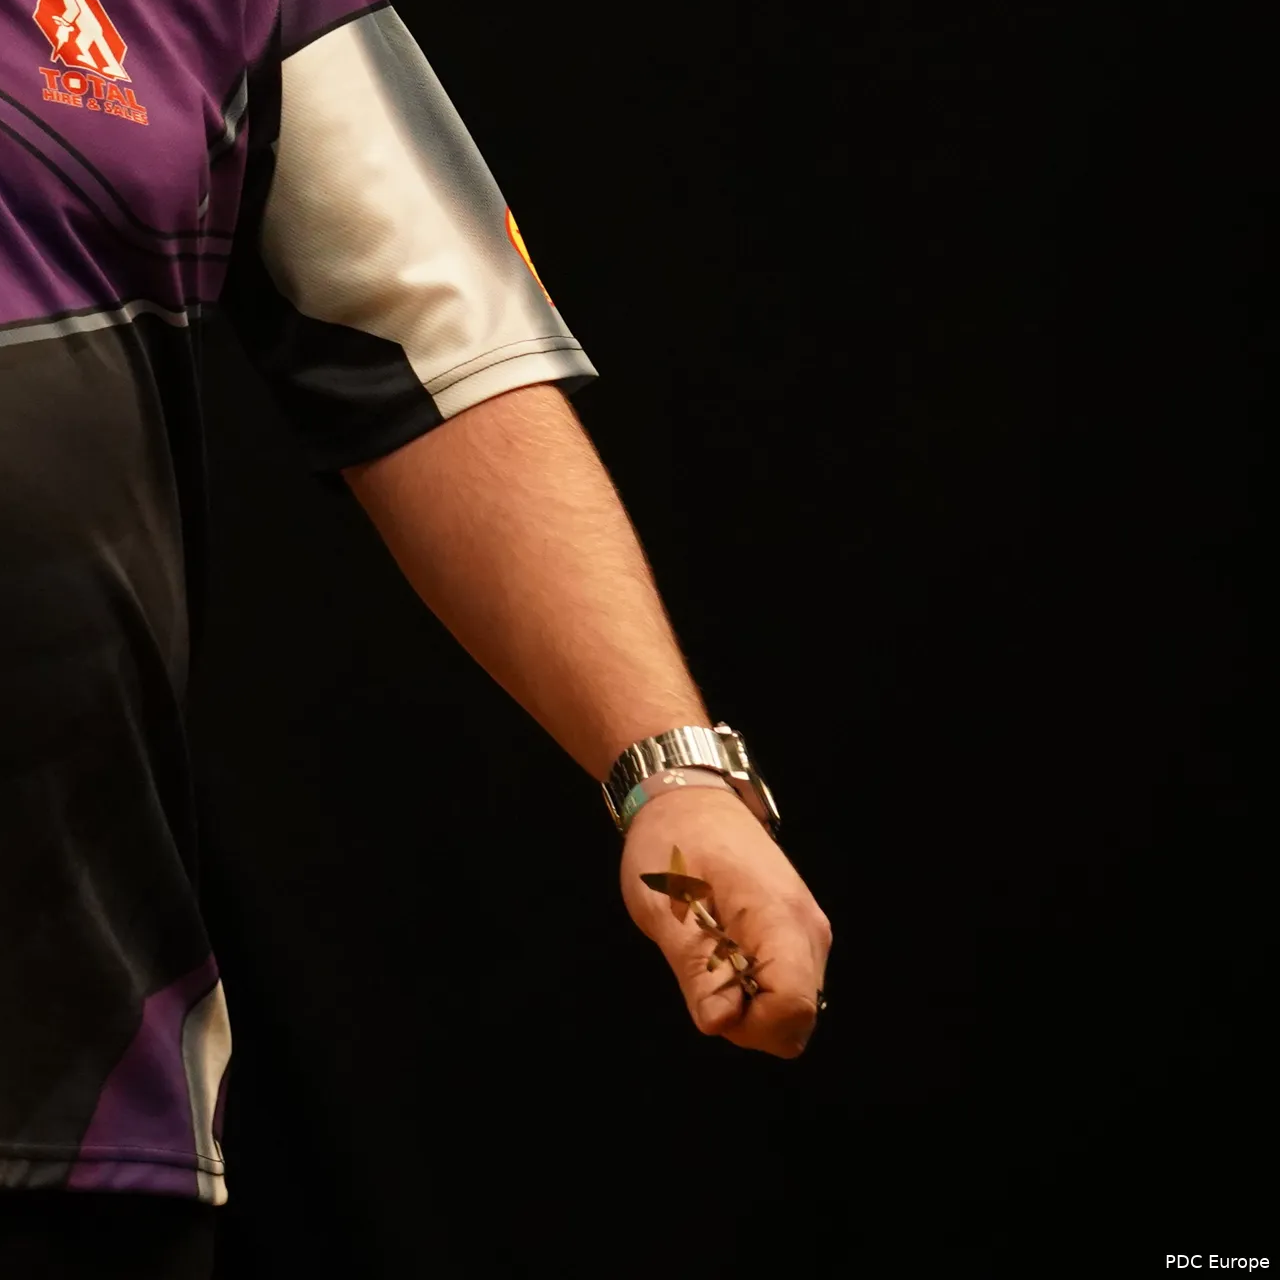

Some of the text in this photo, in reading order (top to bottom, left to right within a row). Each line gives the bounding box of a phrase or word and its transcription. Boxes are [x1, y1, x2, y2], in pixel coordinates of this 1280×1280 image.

[39, 67, 148, 113] TOTAL
[42, 88, 149, 126] HIRE & SALES
